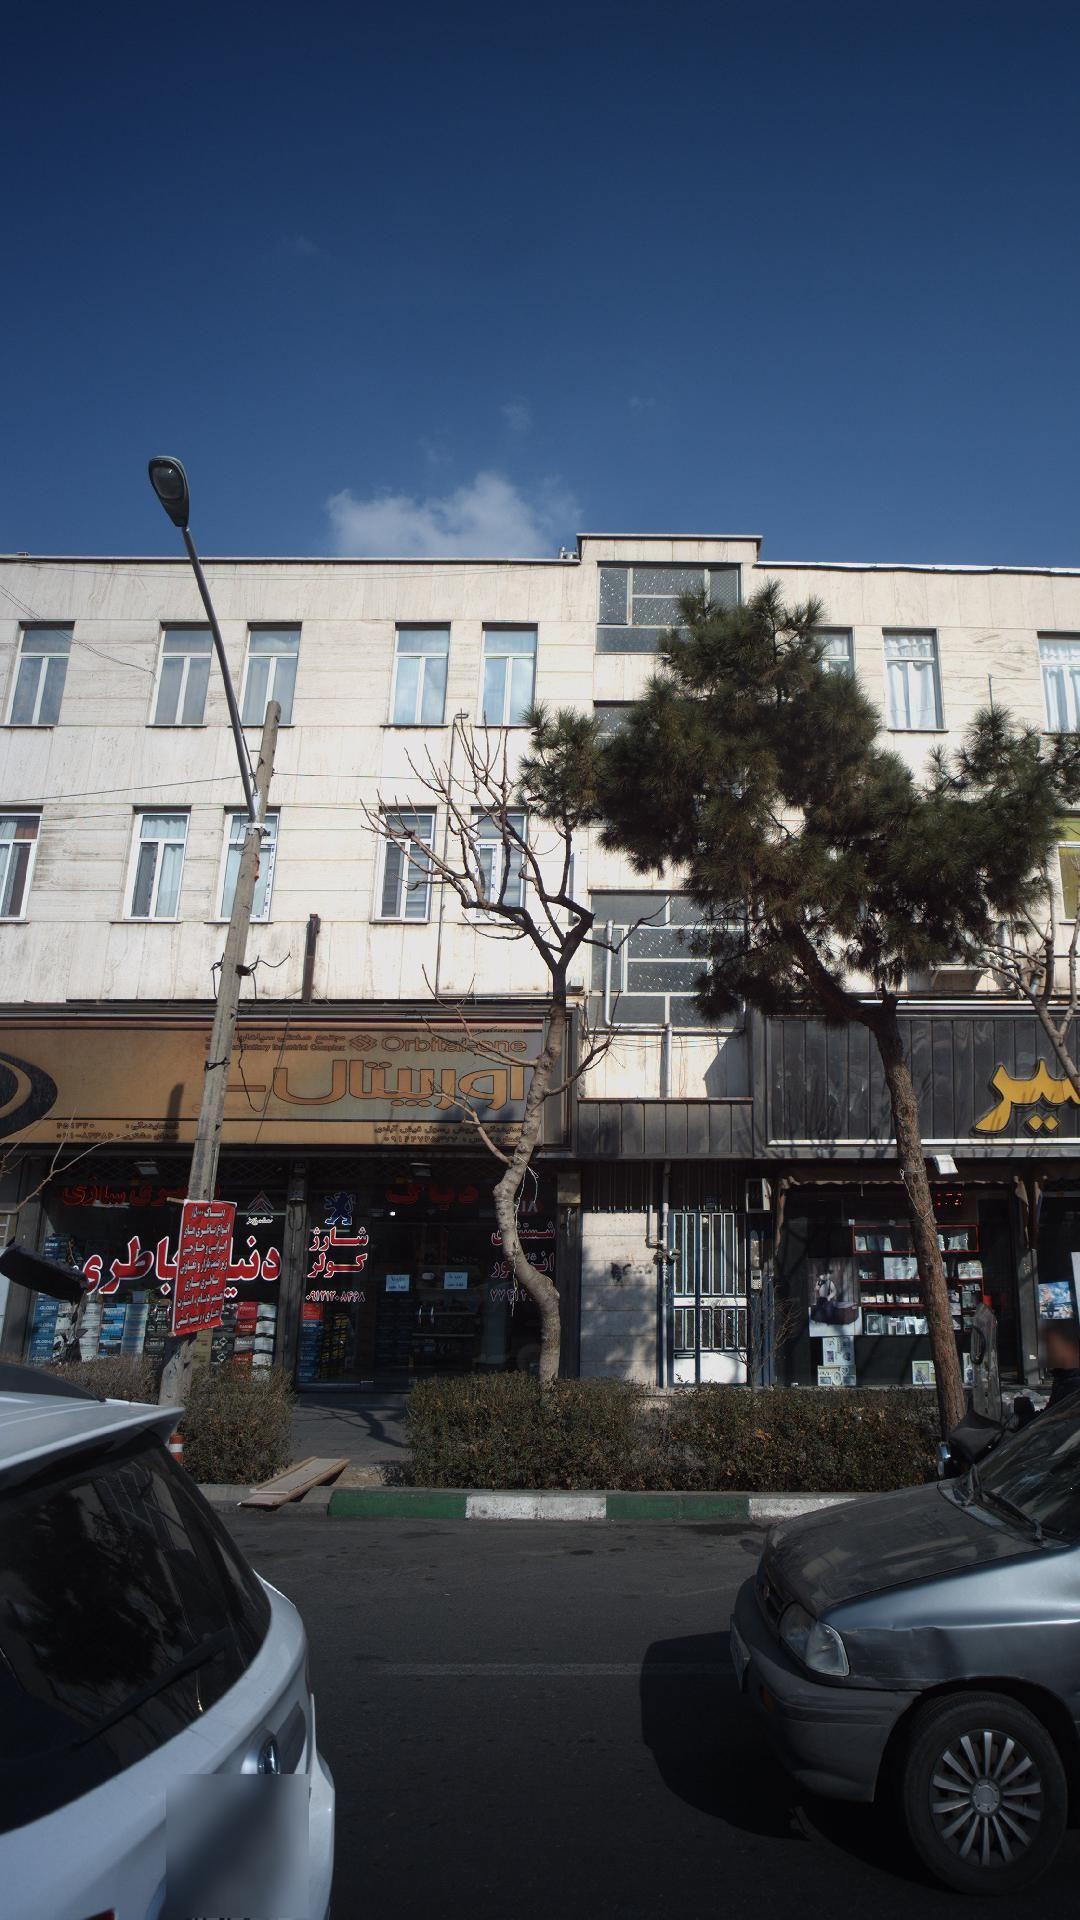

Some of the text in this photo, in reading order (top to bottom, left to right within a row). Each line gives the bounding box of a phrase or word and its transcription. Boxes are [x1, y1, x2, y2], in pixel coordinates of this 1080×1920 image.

[308, 1226, 369, 1252] شارژ
[80, 1235, 181, 1296] باطری
[307, 1252, 369, 1279] کولر
